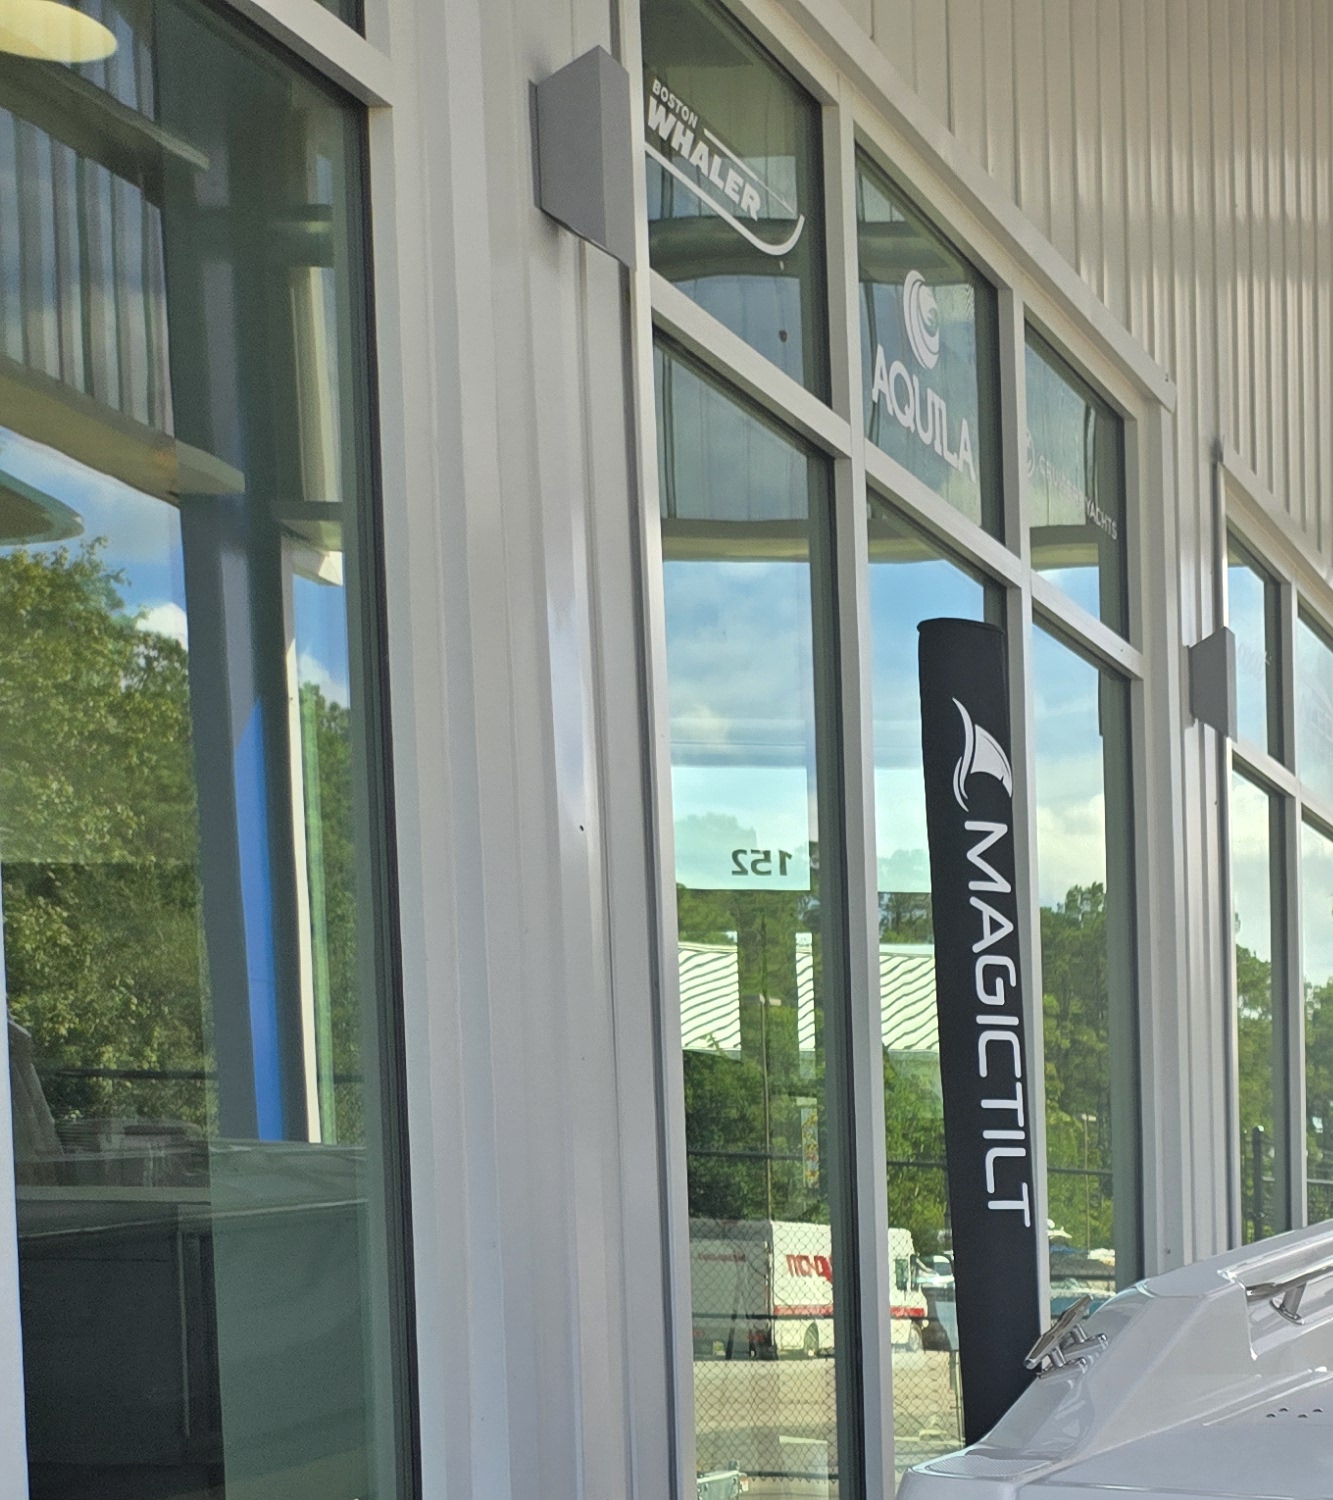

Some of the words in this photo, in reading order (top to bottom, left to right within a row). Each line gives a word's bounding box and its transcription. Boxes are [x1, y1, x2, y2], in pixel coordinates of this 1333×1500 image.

[647, 95, 761, 222] WHALER
[652, 78, 698, 129] BOSTON
[871, 343, 977, 484] AQUILA
[964, 820, 1031, 1228] MAGICTILT
